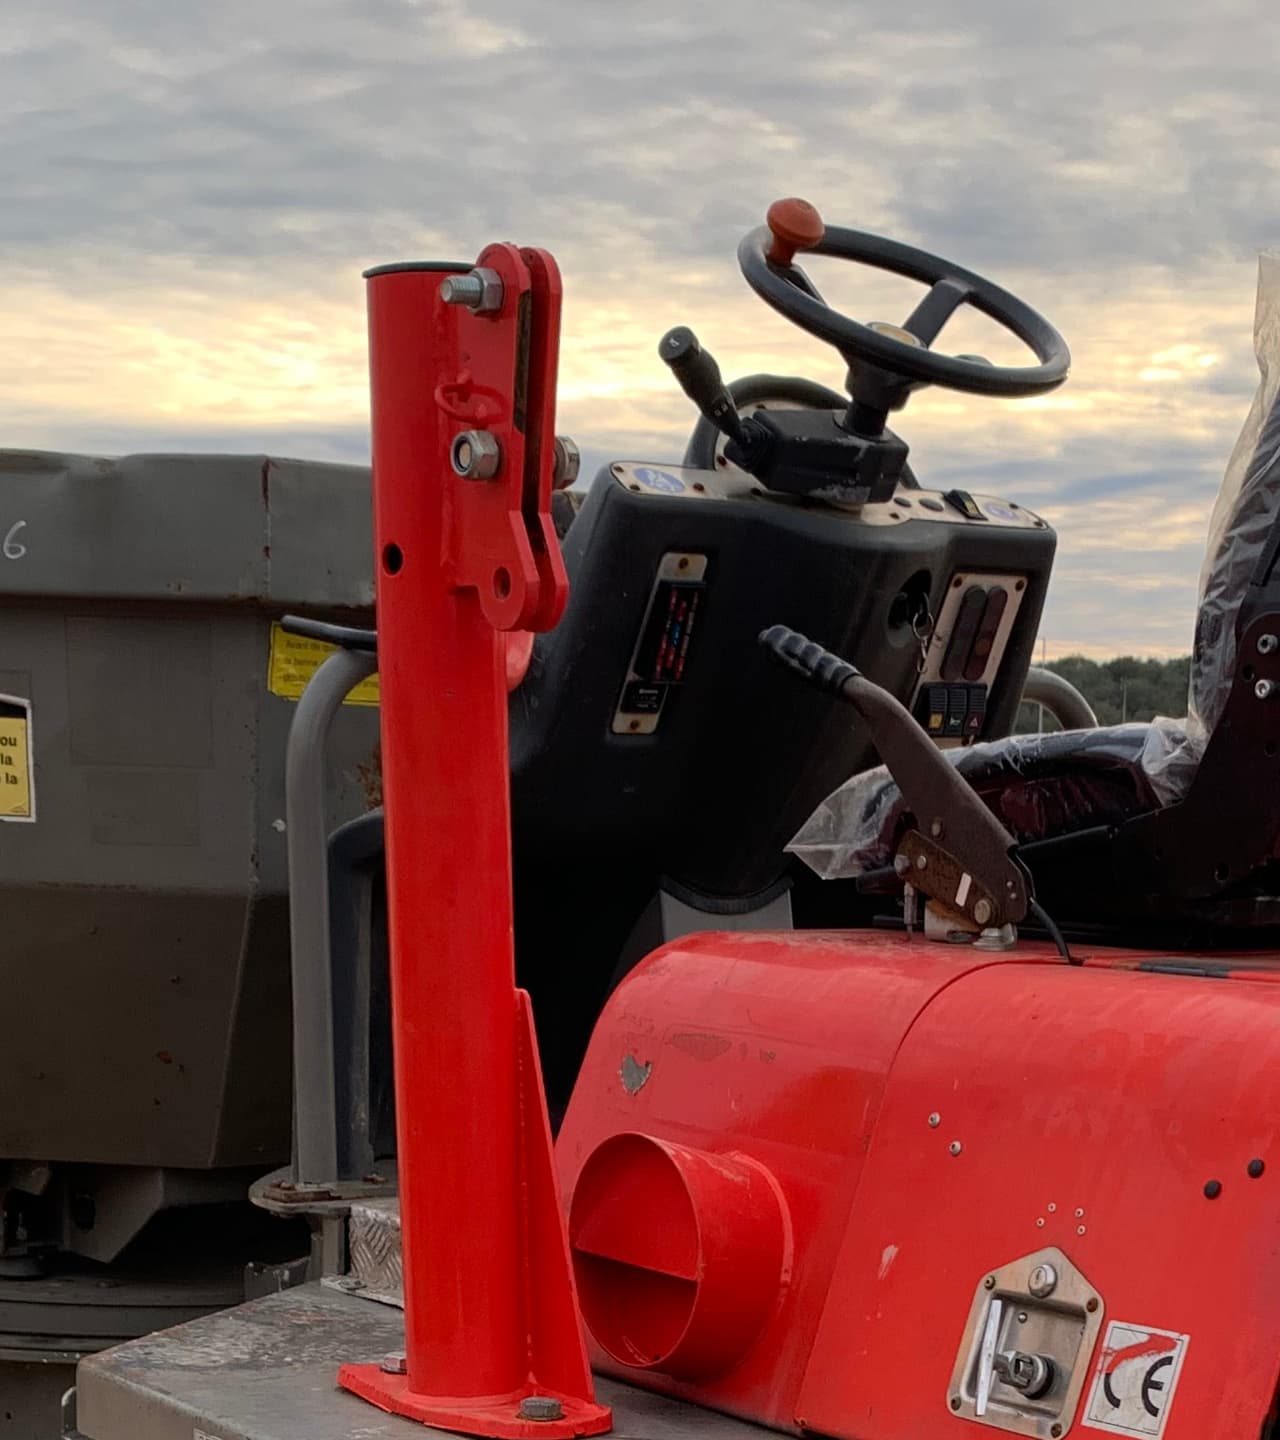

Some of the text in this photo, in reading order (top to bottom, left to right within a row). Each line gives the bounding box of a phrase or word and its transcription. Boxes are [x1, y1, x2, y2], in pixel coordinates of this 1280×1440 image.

[0, 736, 17, 747] ou
[0, 752, 13, 765] la
[5, 772, 18, 785] la
